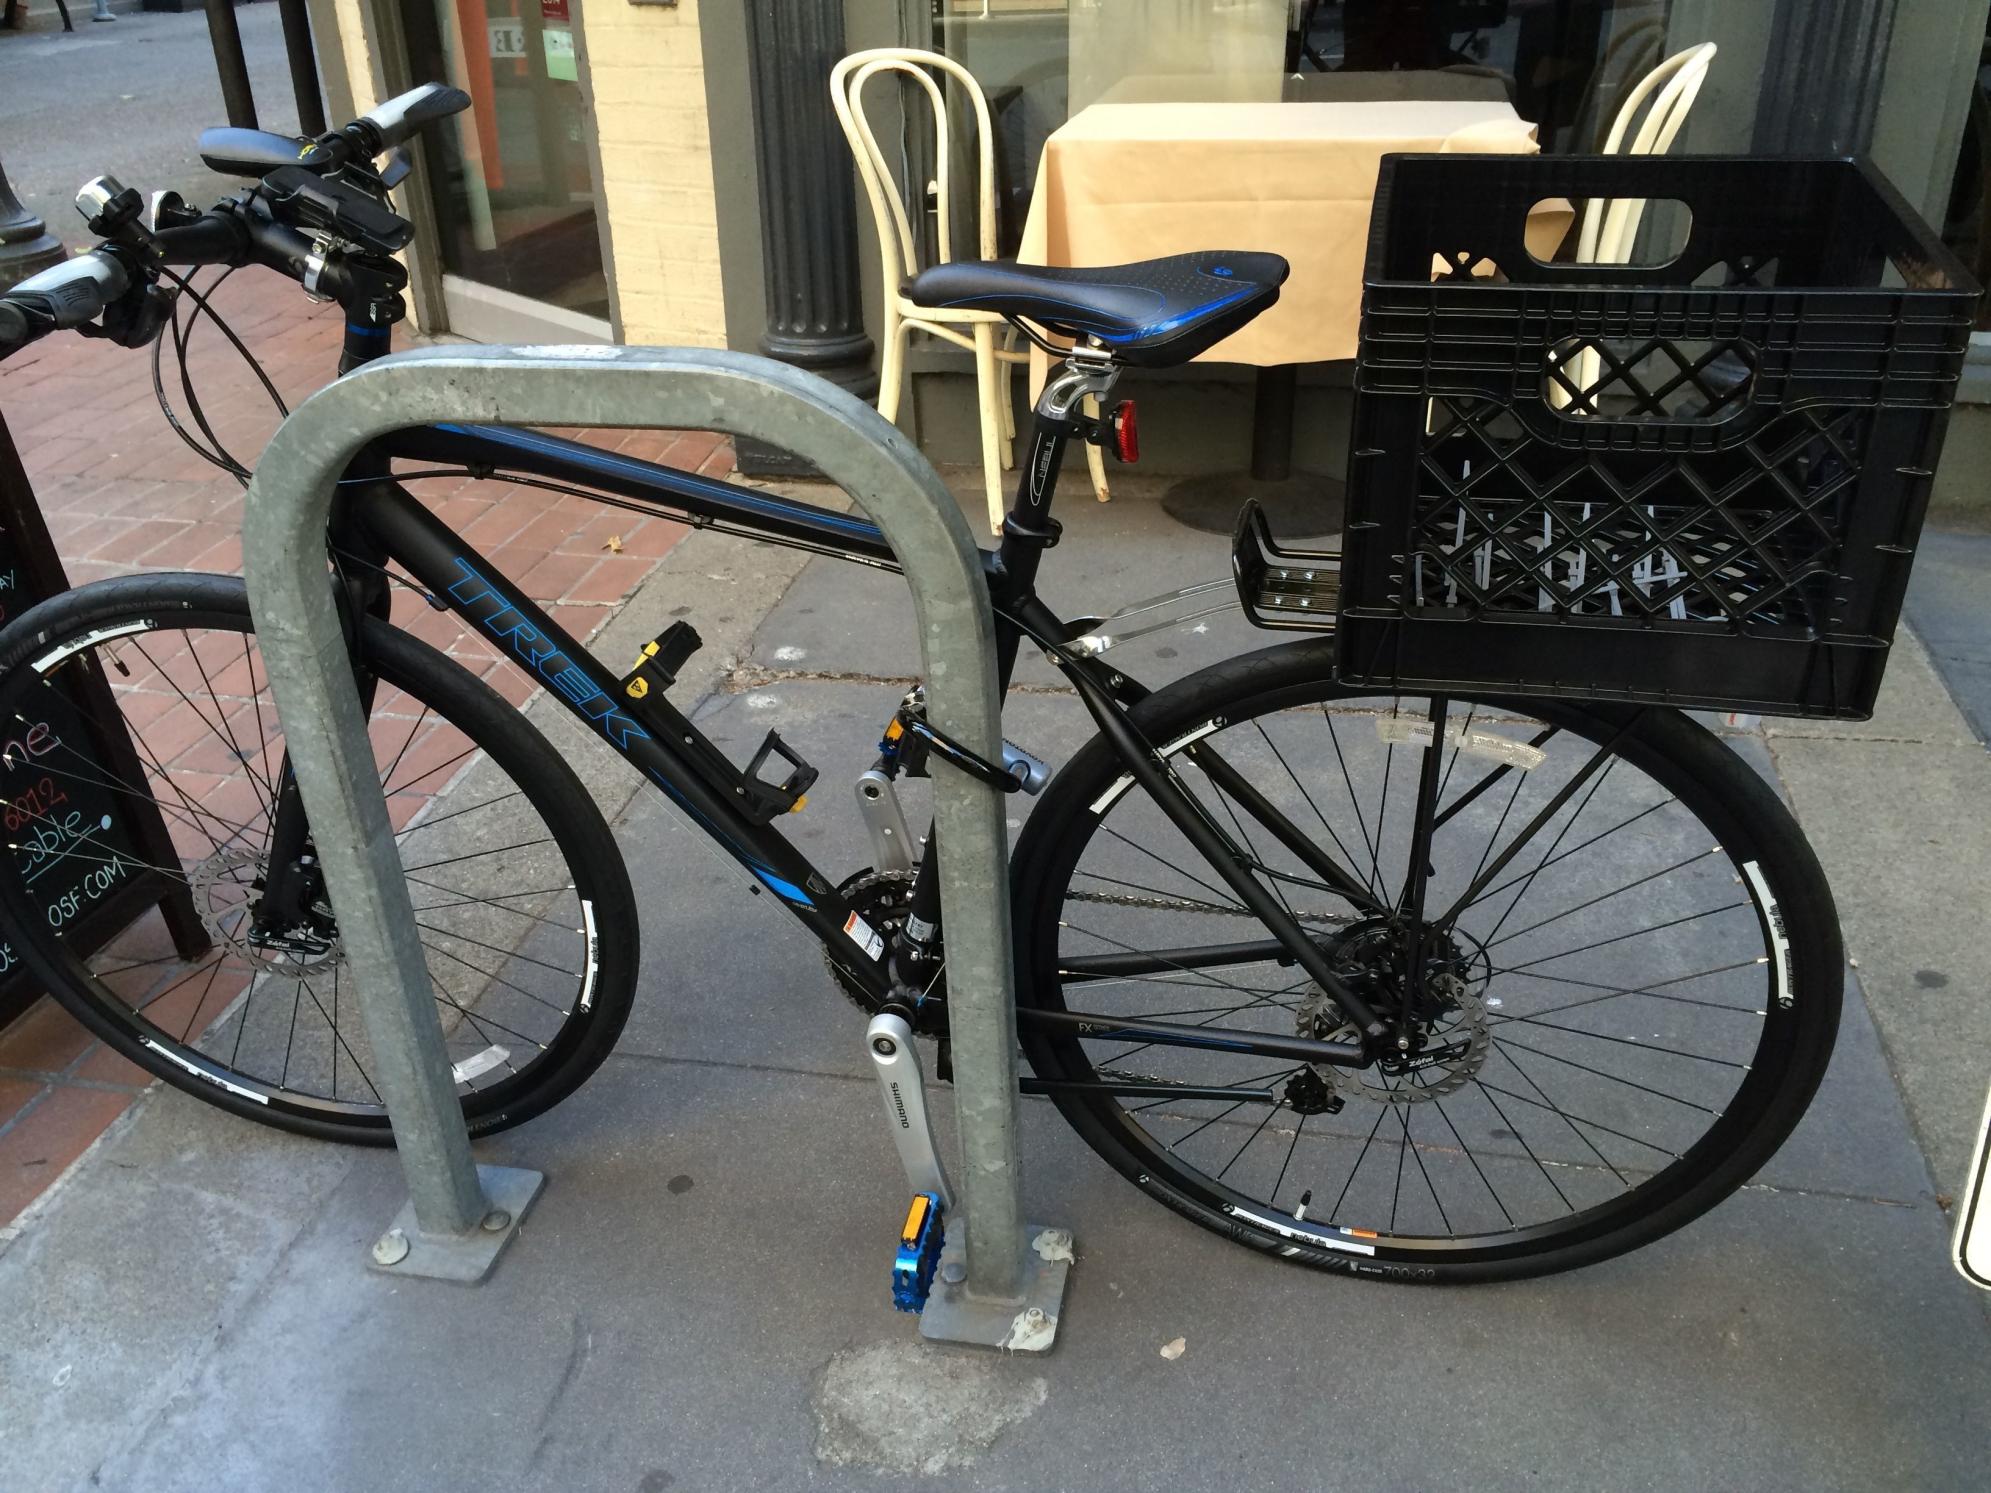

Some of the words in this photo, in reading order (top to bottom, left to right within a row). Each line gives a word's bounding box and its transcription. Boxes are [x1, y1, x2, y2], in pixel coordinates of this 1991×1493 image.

[448, 557, 652, 750] TREK
[1079, 1022, 1093, 1033] FX
[890, 1081, 910, 1129] SHIMANO
